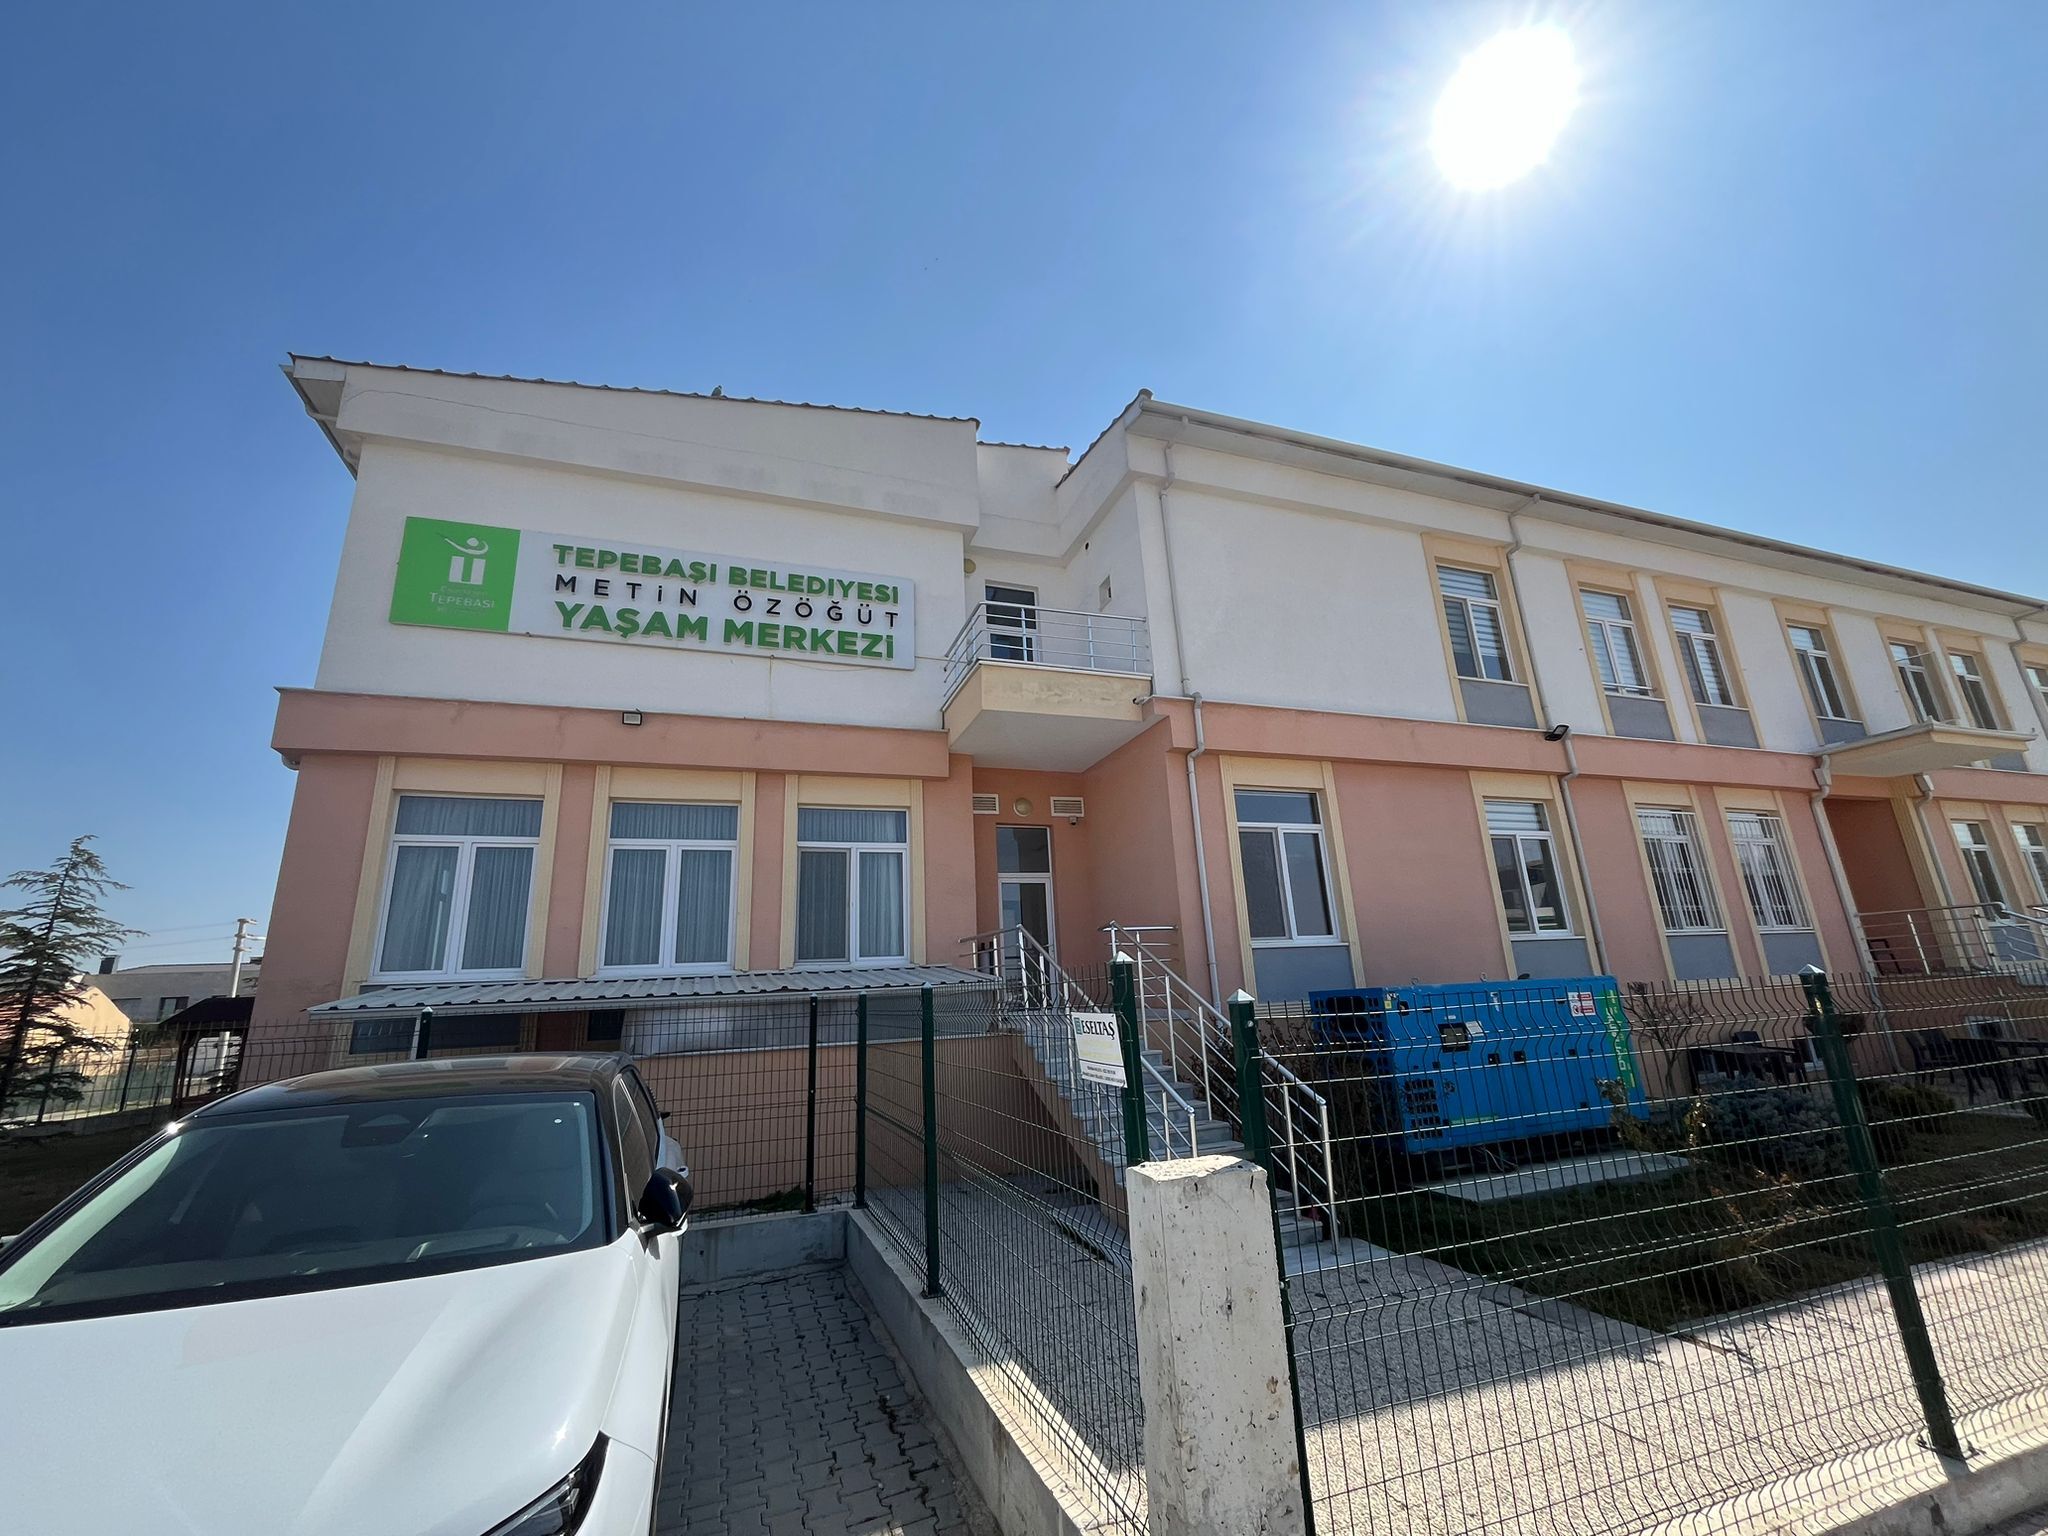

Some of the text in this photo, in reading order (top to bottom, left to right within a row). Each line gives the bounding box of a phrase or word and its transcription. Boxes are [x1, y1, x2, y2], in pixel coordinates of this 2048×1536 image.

[553, 544, 717, 584] TEPEBAŞI
[555, 574, 898, 628] METİN ÖZÖĞÜT
[554, 600, 894, 659] YAŞAM MERKEZİ
